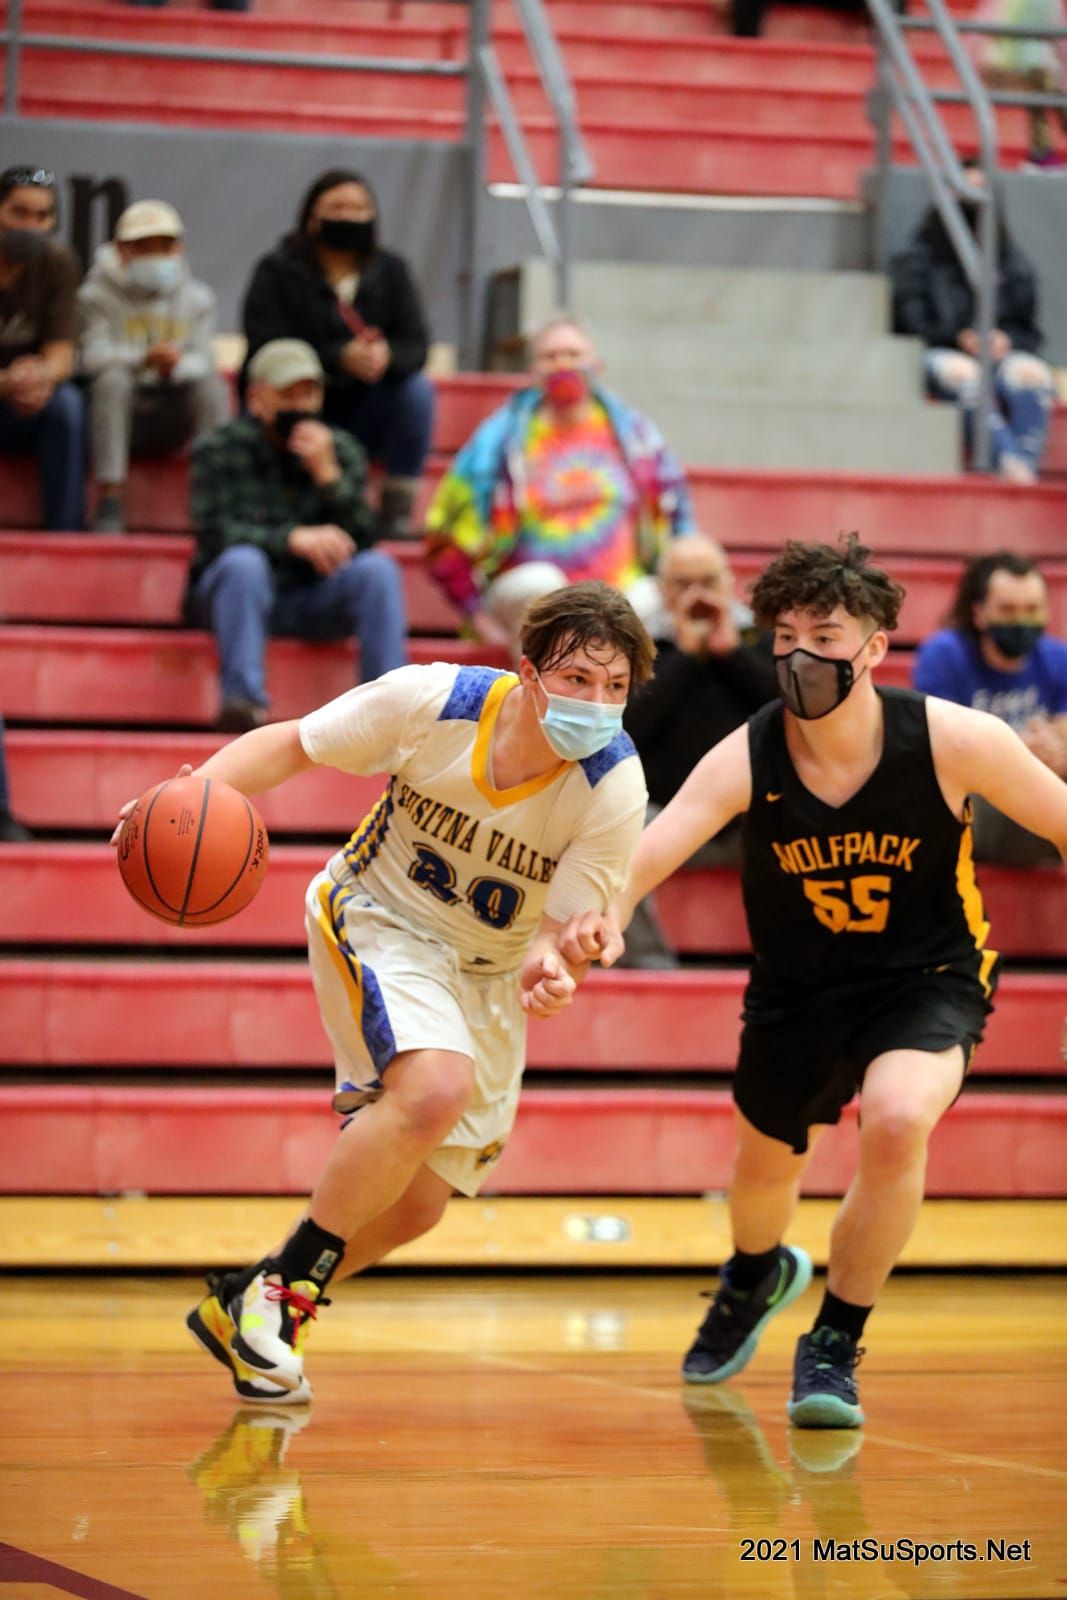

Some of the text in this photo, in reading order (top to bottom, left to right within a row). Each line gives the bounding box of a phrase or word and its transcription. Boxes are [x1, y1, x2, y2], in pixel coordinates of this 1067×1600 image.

[398, 783, 559, 884] SUSITNA VALLE
[771, 831, 921, 874] WOLFPACK
[803, 874, 892, 934] 55
